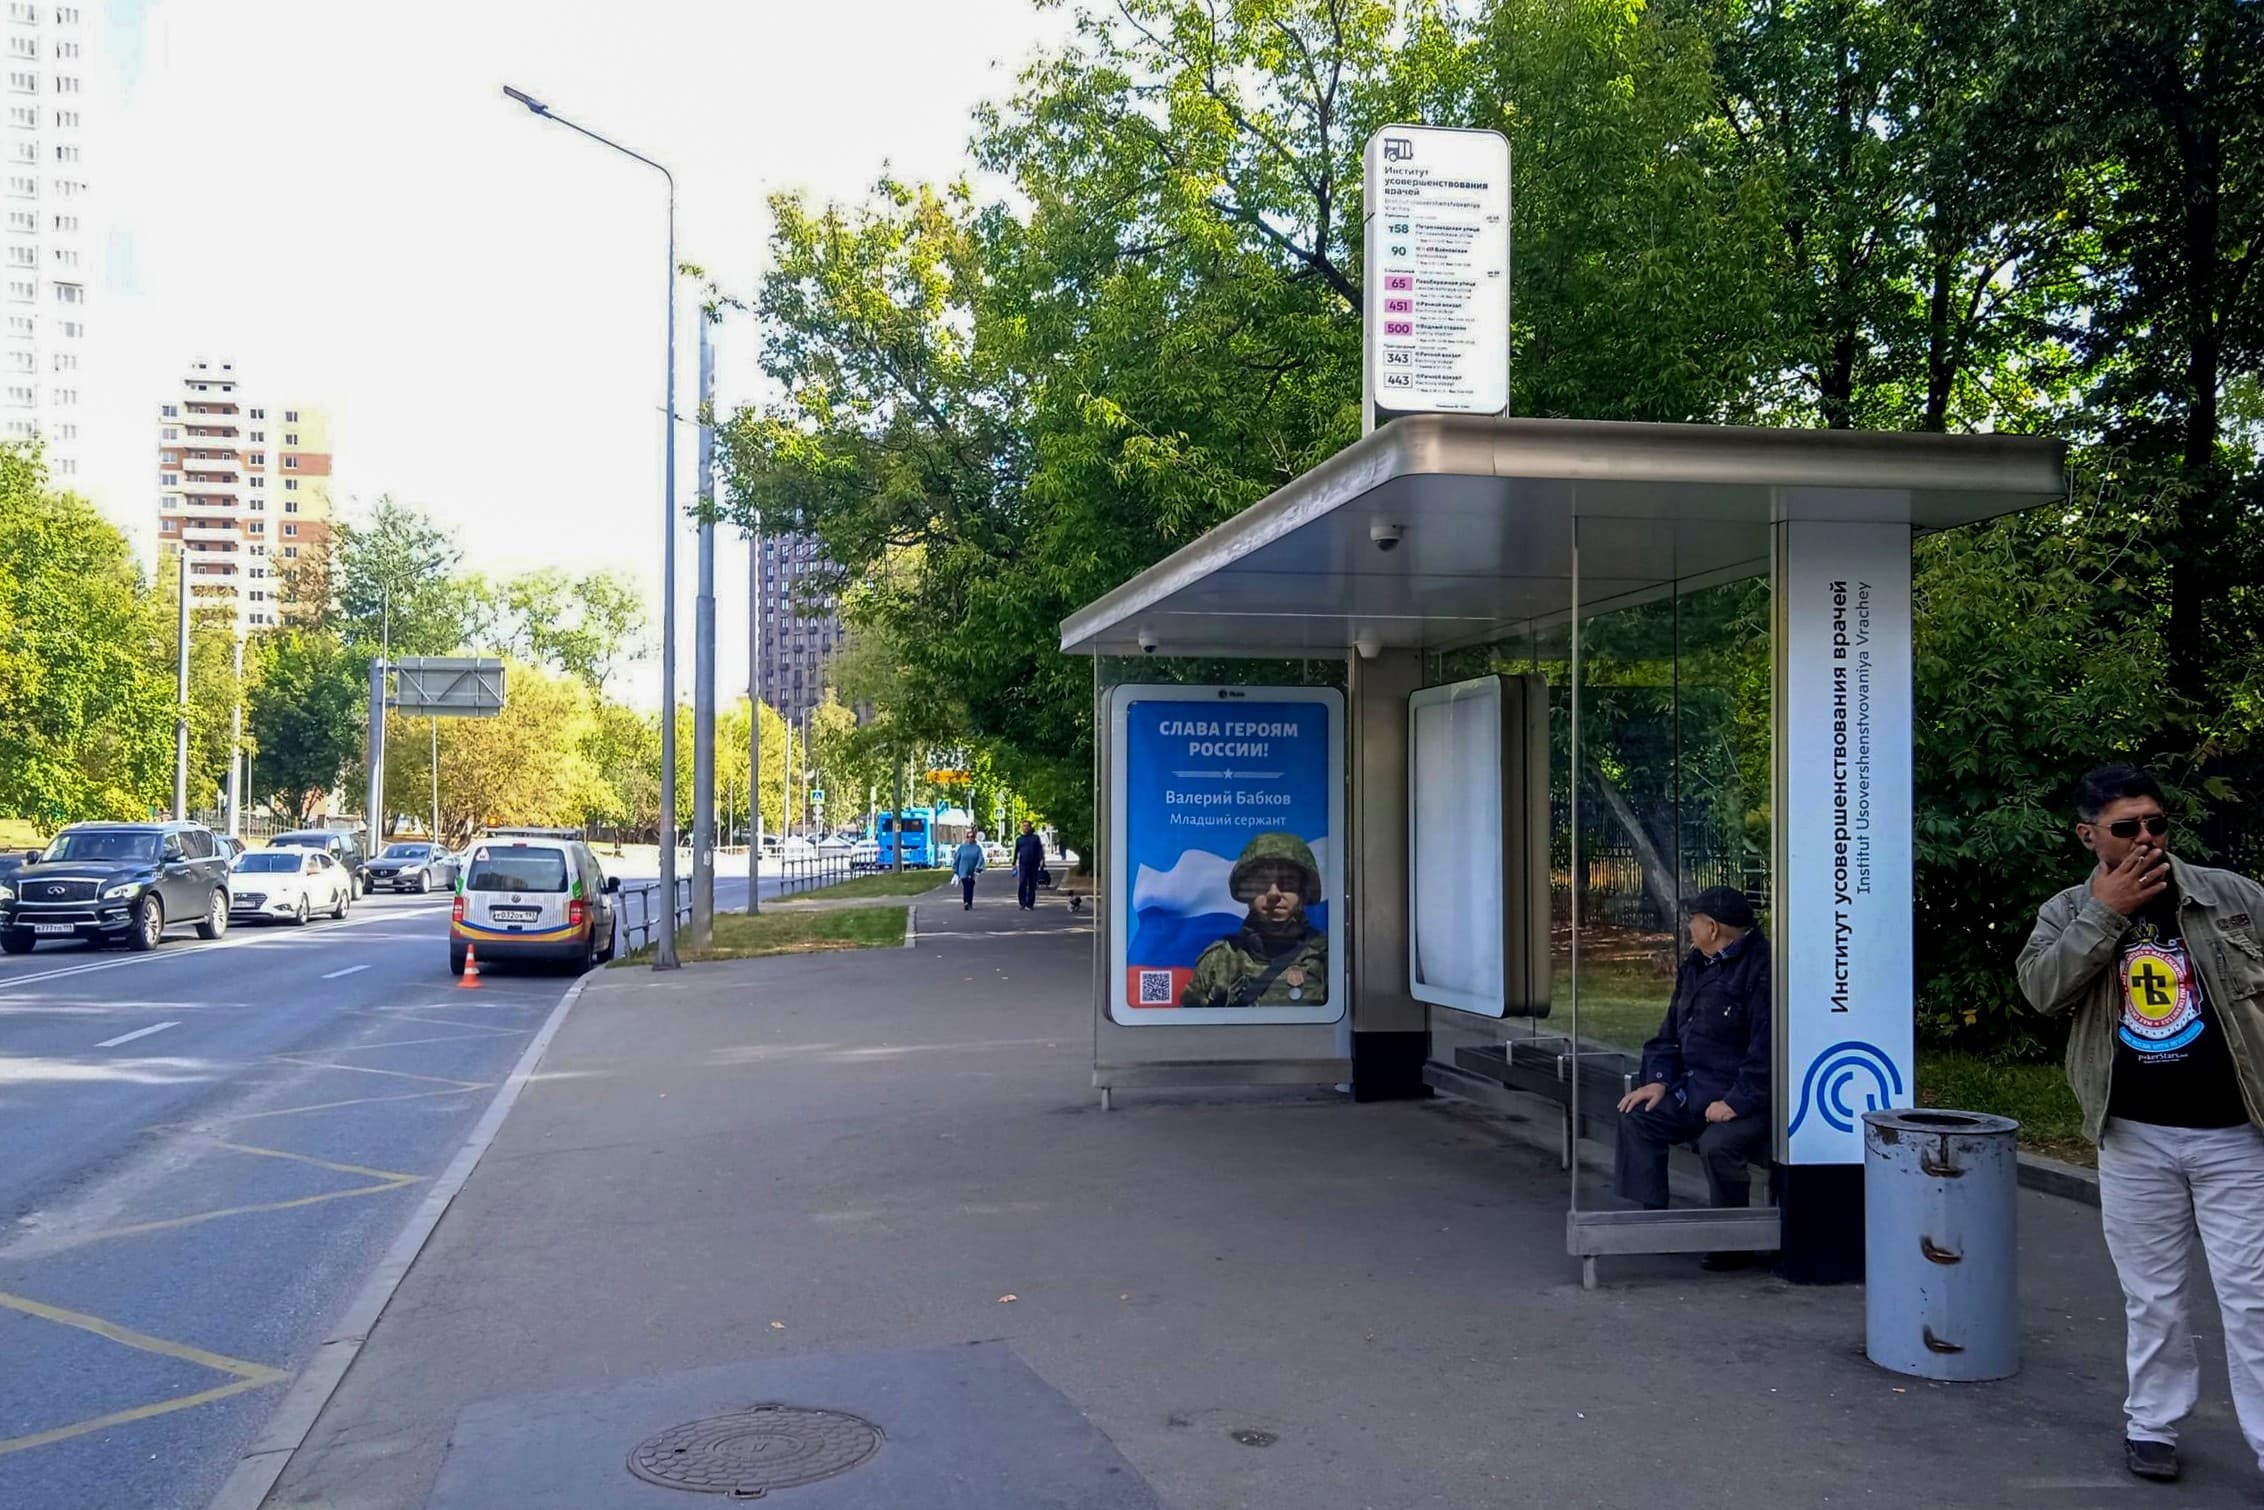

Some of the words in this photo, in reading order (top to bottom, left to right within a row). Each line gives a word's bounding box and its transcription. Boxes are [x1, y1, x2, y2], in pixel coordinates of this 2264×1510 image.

[1384, 166, 1429, 178] Институт
[1384, 178, 1488, 190] усовершенствования
[1384, 188, 1420, 196] врачей
[1391, 246, 1406, 256] 90
[1391, 279, 1406, 289] 65
[1389, 301, 1408, 311] 451
[1387, 323, 1410, 334] 500
[1387, 353, 1409, 363] 343
[1387, 375, 1410, 386] 443
[1829, 581, 1850, 659] врачей
[1856, 581, 1872, 647] Vrachey
[1159, 721, 1220, 736] СЛАВА
[1225, 721, 1299, 737] ГЕРОЯМ
[1188, 741, 1269, 757] РОССИИ!
[1856, 651, 1872, 831] Usovershenstvovaniya
[1833, 667, 1852, 906] усовершенствования
[1165, 790, 1232, 808] Валерий
[1236, 790, 1292, 806] Бабков
[1169, 812, 1232, 827] Младший
[1234, 815, 1287, 828] сержант
[1857, 834, 1871, 895] Institut
[1831, 911, 1852, 1014] Институт
